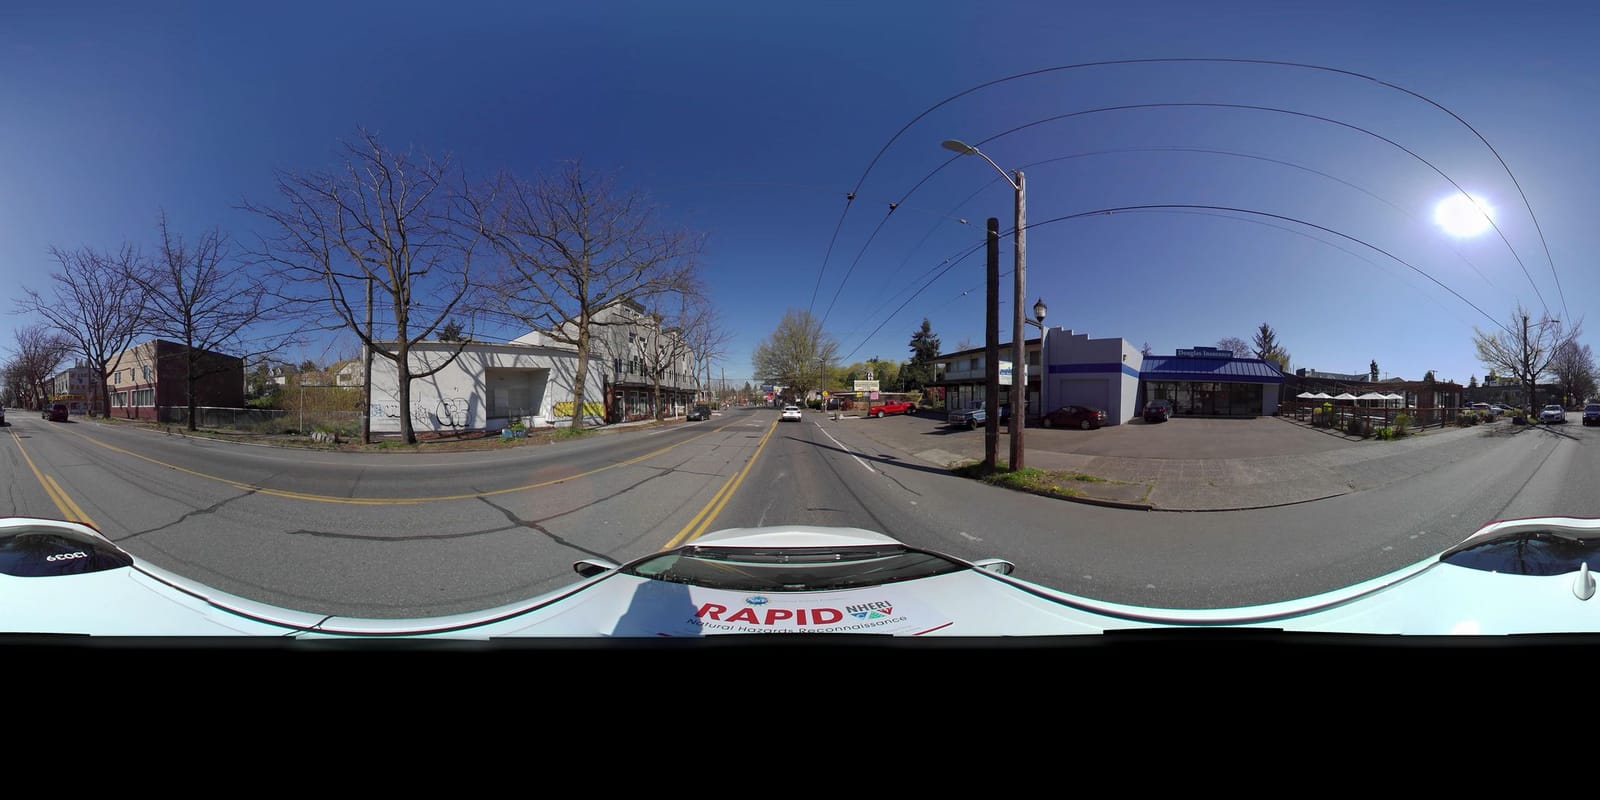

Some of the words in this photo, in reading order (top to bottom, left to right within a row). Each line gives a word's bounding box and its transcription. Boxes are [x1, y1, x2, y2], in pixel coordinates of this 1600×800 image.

[46, 551, 88, 561] 13039
[694, 603, 844, 626] RAPID
[845, 600, 893, 613] NHERI
[686, 618, 735, 631] Natural
[739, 625, 794, 633] Hazards
[798, 615, 907, 634] Reconnaissance
